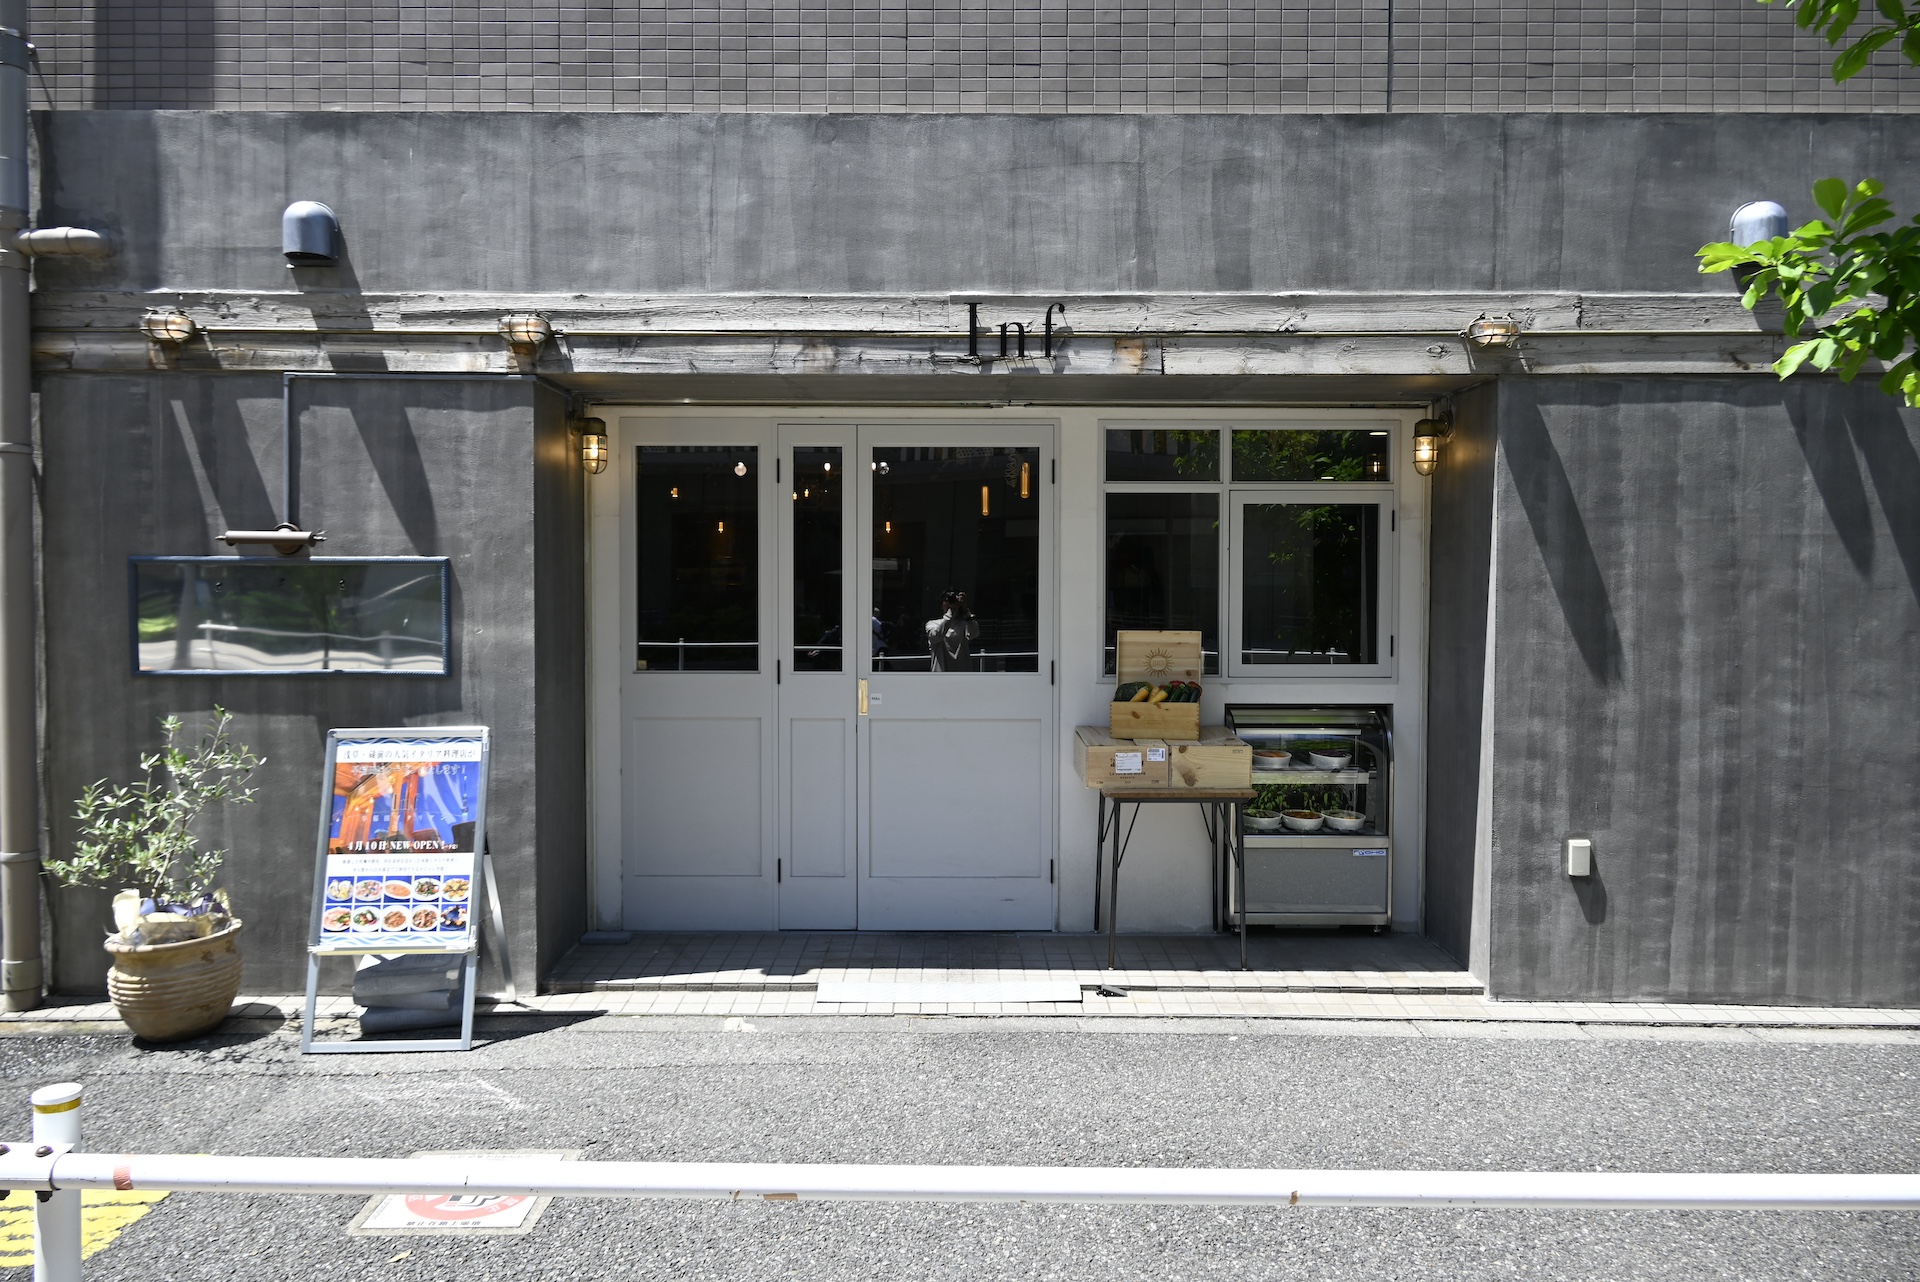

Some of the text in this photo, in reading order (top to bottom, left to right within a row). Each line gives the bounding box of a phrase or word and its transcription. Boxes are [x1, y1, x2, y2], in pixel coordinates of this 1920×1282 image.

[964, 302, 1066, 358] Inf
[343, 749, 476, 760] 浅草・蔵前の人気イタリア料理店が
[389, 841, 411, 850] NEW
